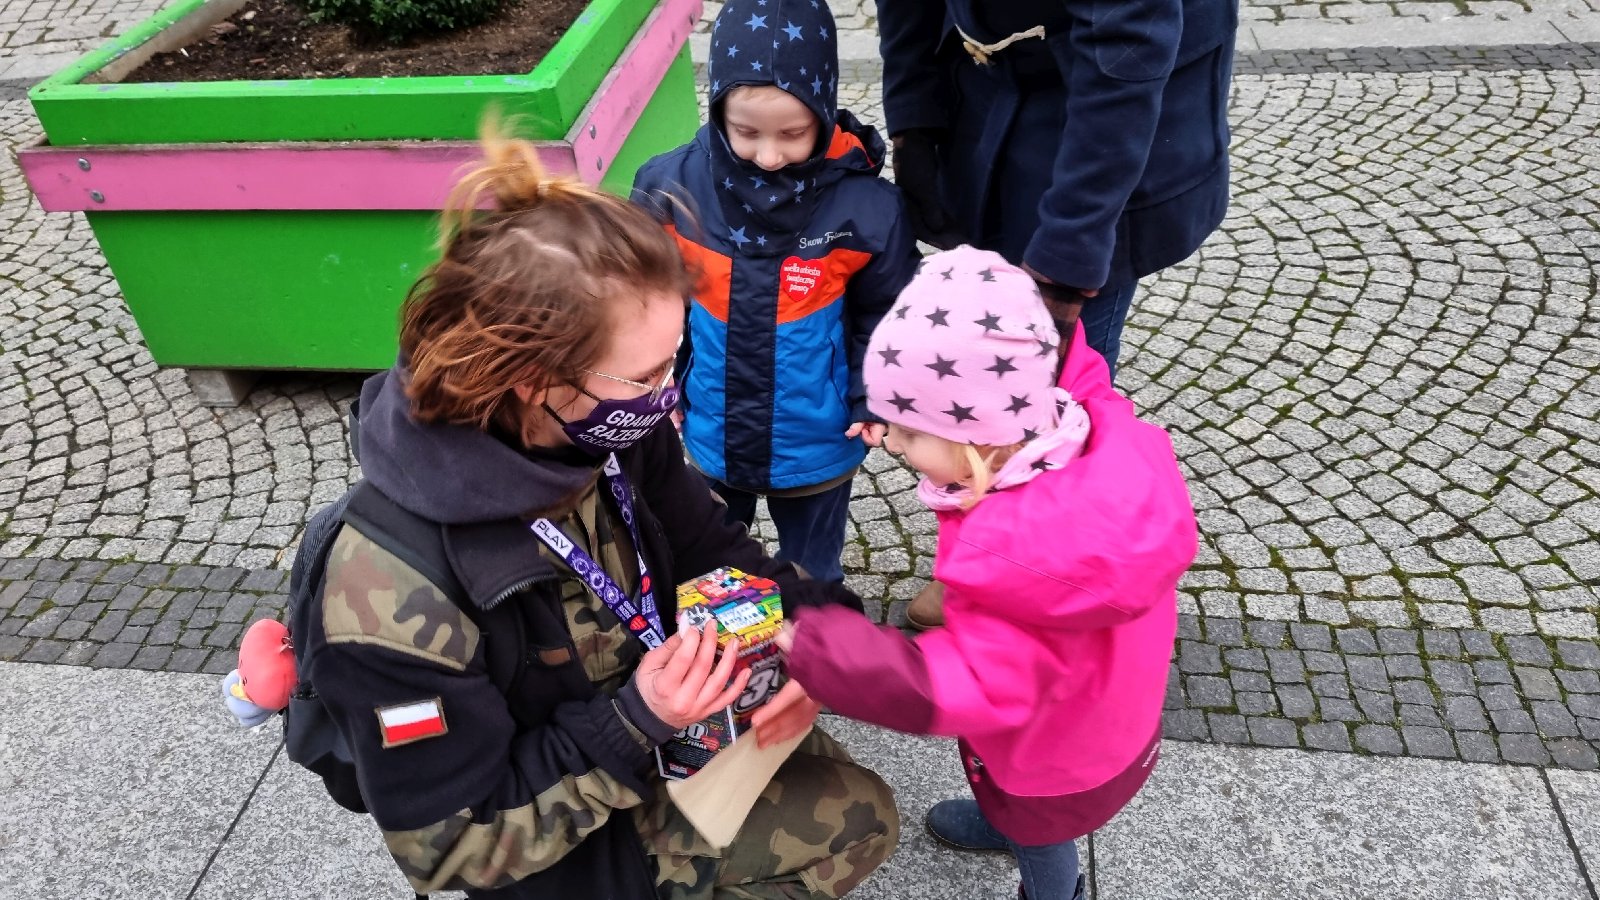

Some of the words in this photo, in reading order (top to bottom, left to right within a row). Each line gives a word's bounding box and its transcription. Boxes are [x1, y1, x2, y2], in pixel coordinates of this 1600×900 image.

[606, 409, 667, 428] GRAMY
[536, 520, 569, 550] PLAY
[643, 632, 661, 649] PL
